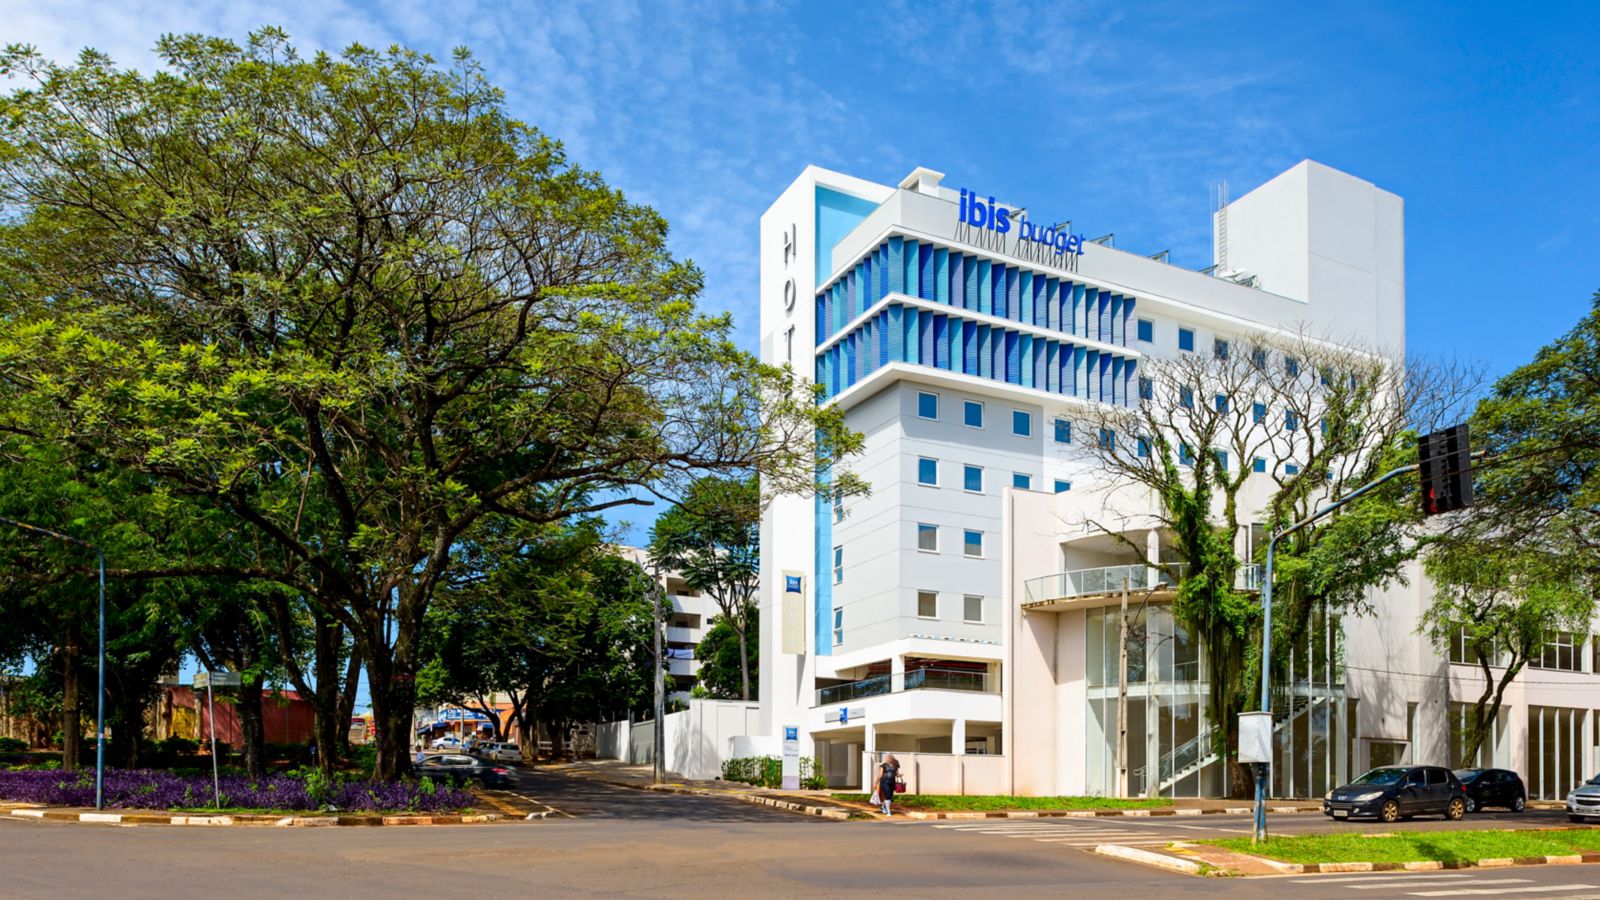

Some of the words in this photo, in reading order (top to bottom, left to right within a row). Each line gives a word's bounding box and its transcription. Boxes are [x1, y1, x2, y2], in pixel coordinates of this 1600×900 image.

[959, 187, 1010, 233] ibis
[1019, 215, 1086, 255] budget
[783, 223, 797, 400] HOT
